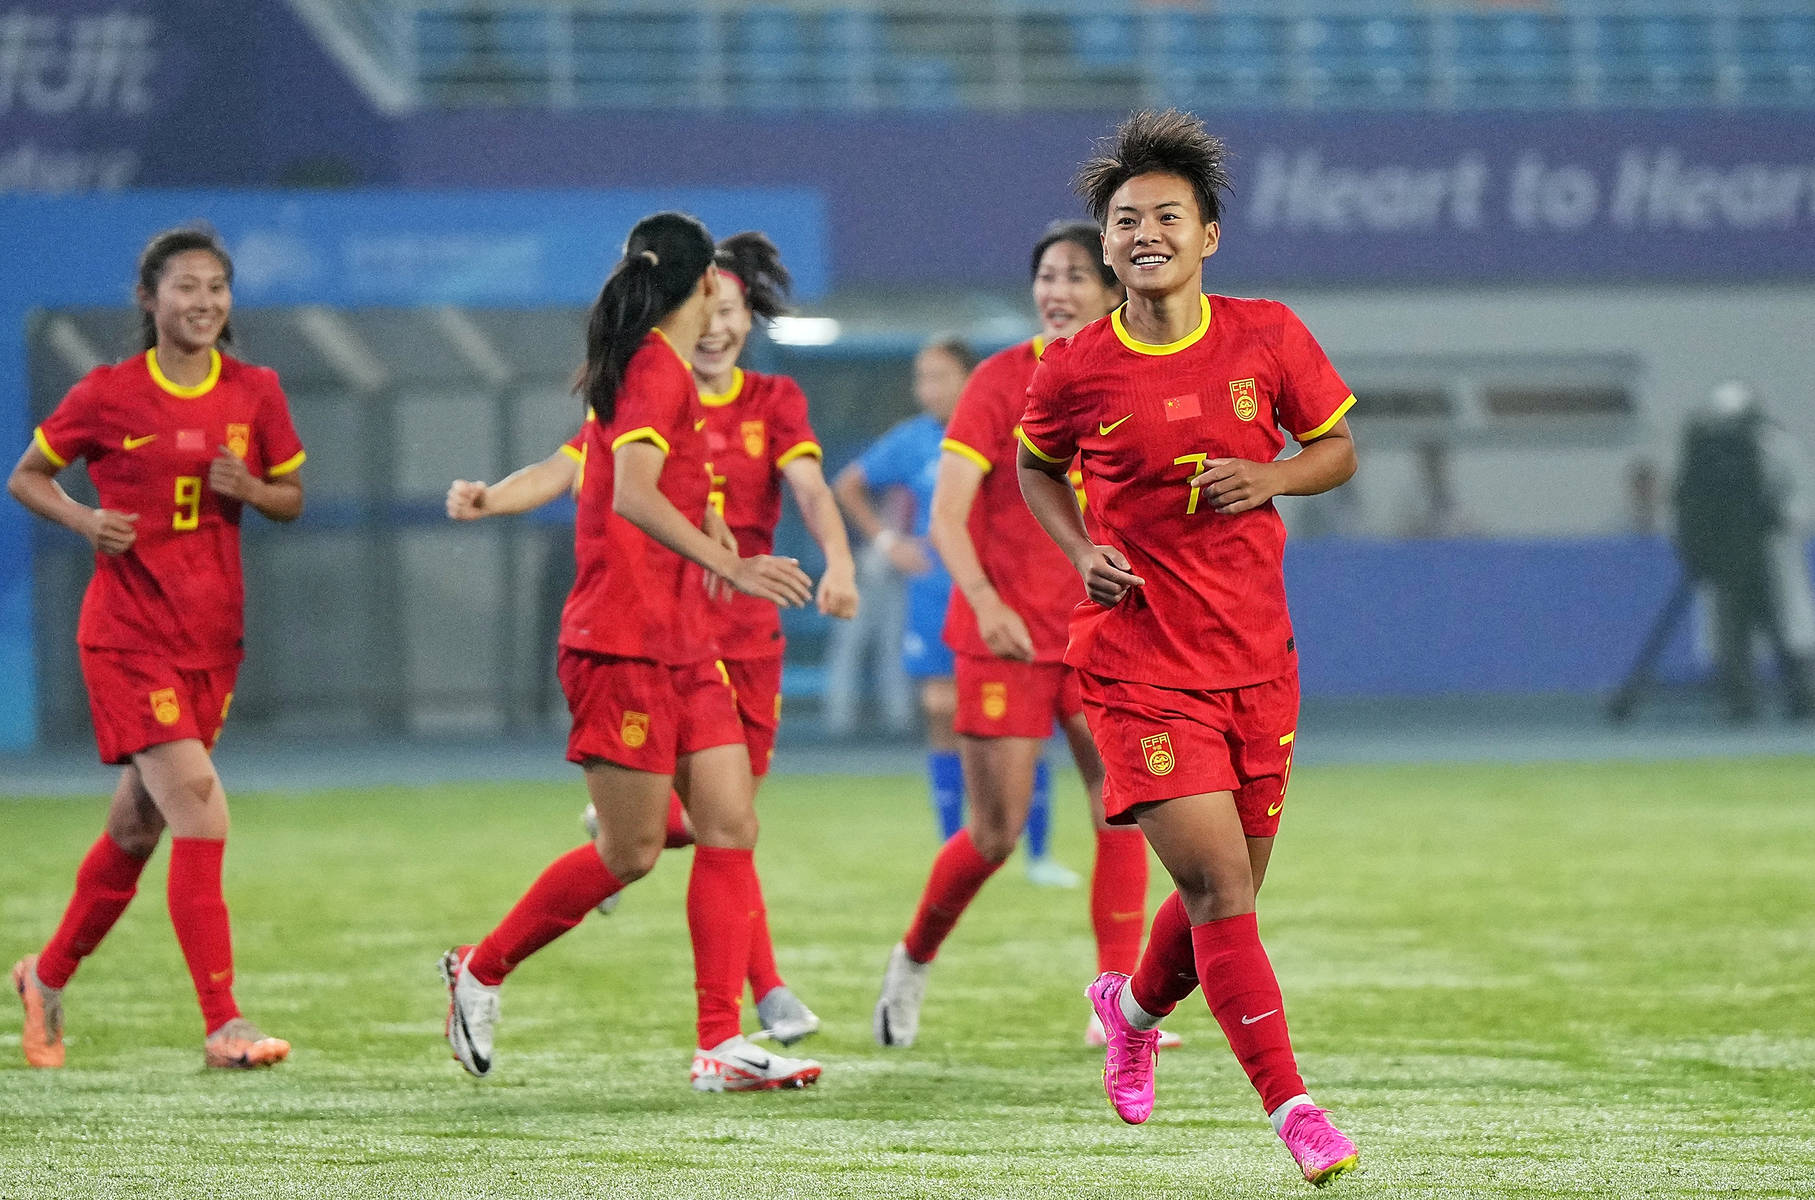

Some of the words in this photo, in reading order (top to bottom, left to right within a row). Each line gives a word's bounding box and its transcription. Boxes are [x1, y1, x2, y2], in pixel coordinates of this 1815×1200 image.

[1246, 147, 1489, 230] Heart
[1508, 148, 1600, 230] to
[1609, 145, 1815, 230] Hear
[1232, 381, 1253, 391] CFA
[172, 476, 202, 530] 9
[1174, 453, 1208, 514] 7
[1144, 736, 1167, 748] CFA
